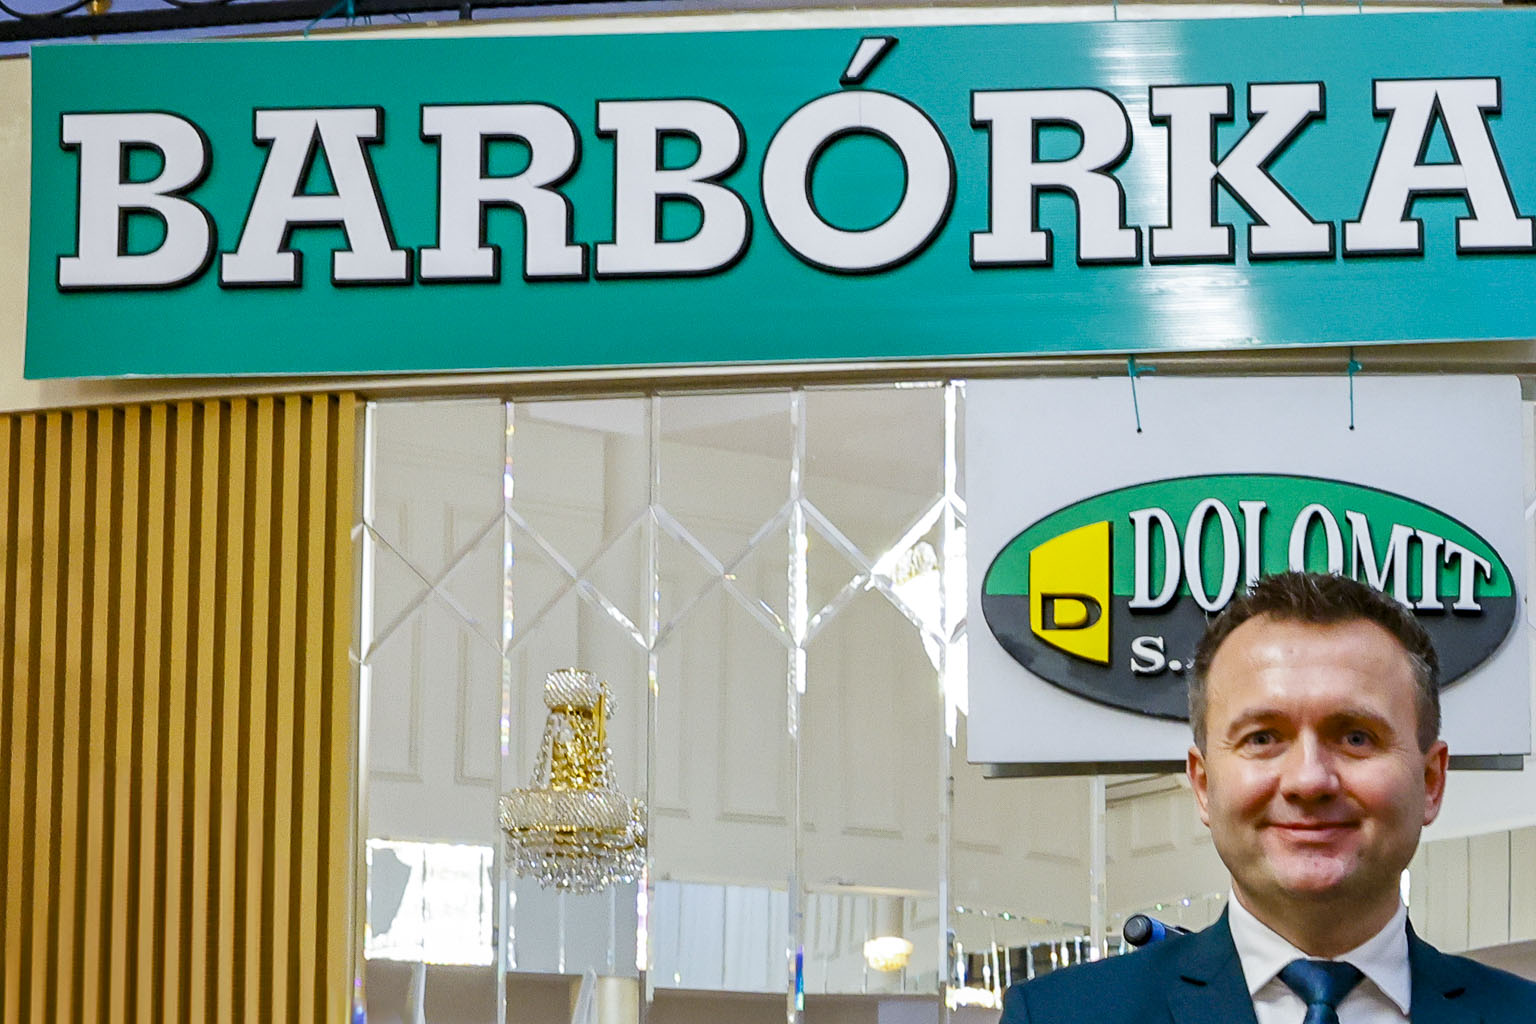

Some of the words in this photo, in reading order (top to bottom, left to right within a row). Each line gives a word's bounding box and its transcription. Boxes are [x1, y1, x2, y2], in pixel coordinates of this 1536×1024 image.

[1128, 497, 1493, 613] DOLOMIT
[1041, 592, 1102, 631] D
[1130, 635, 1195, 673] S.
